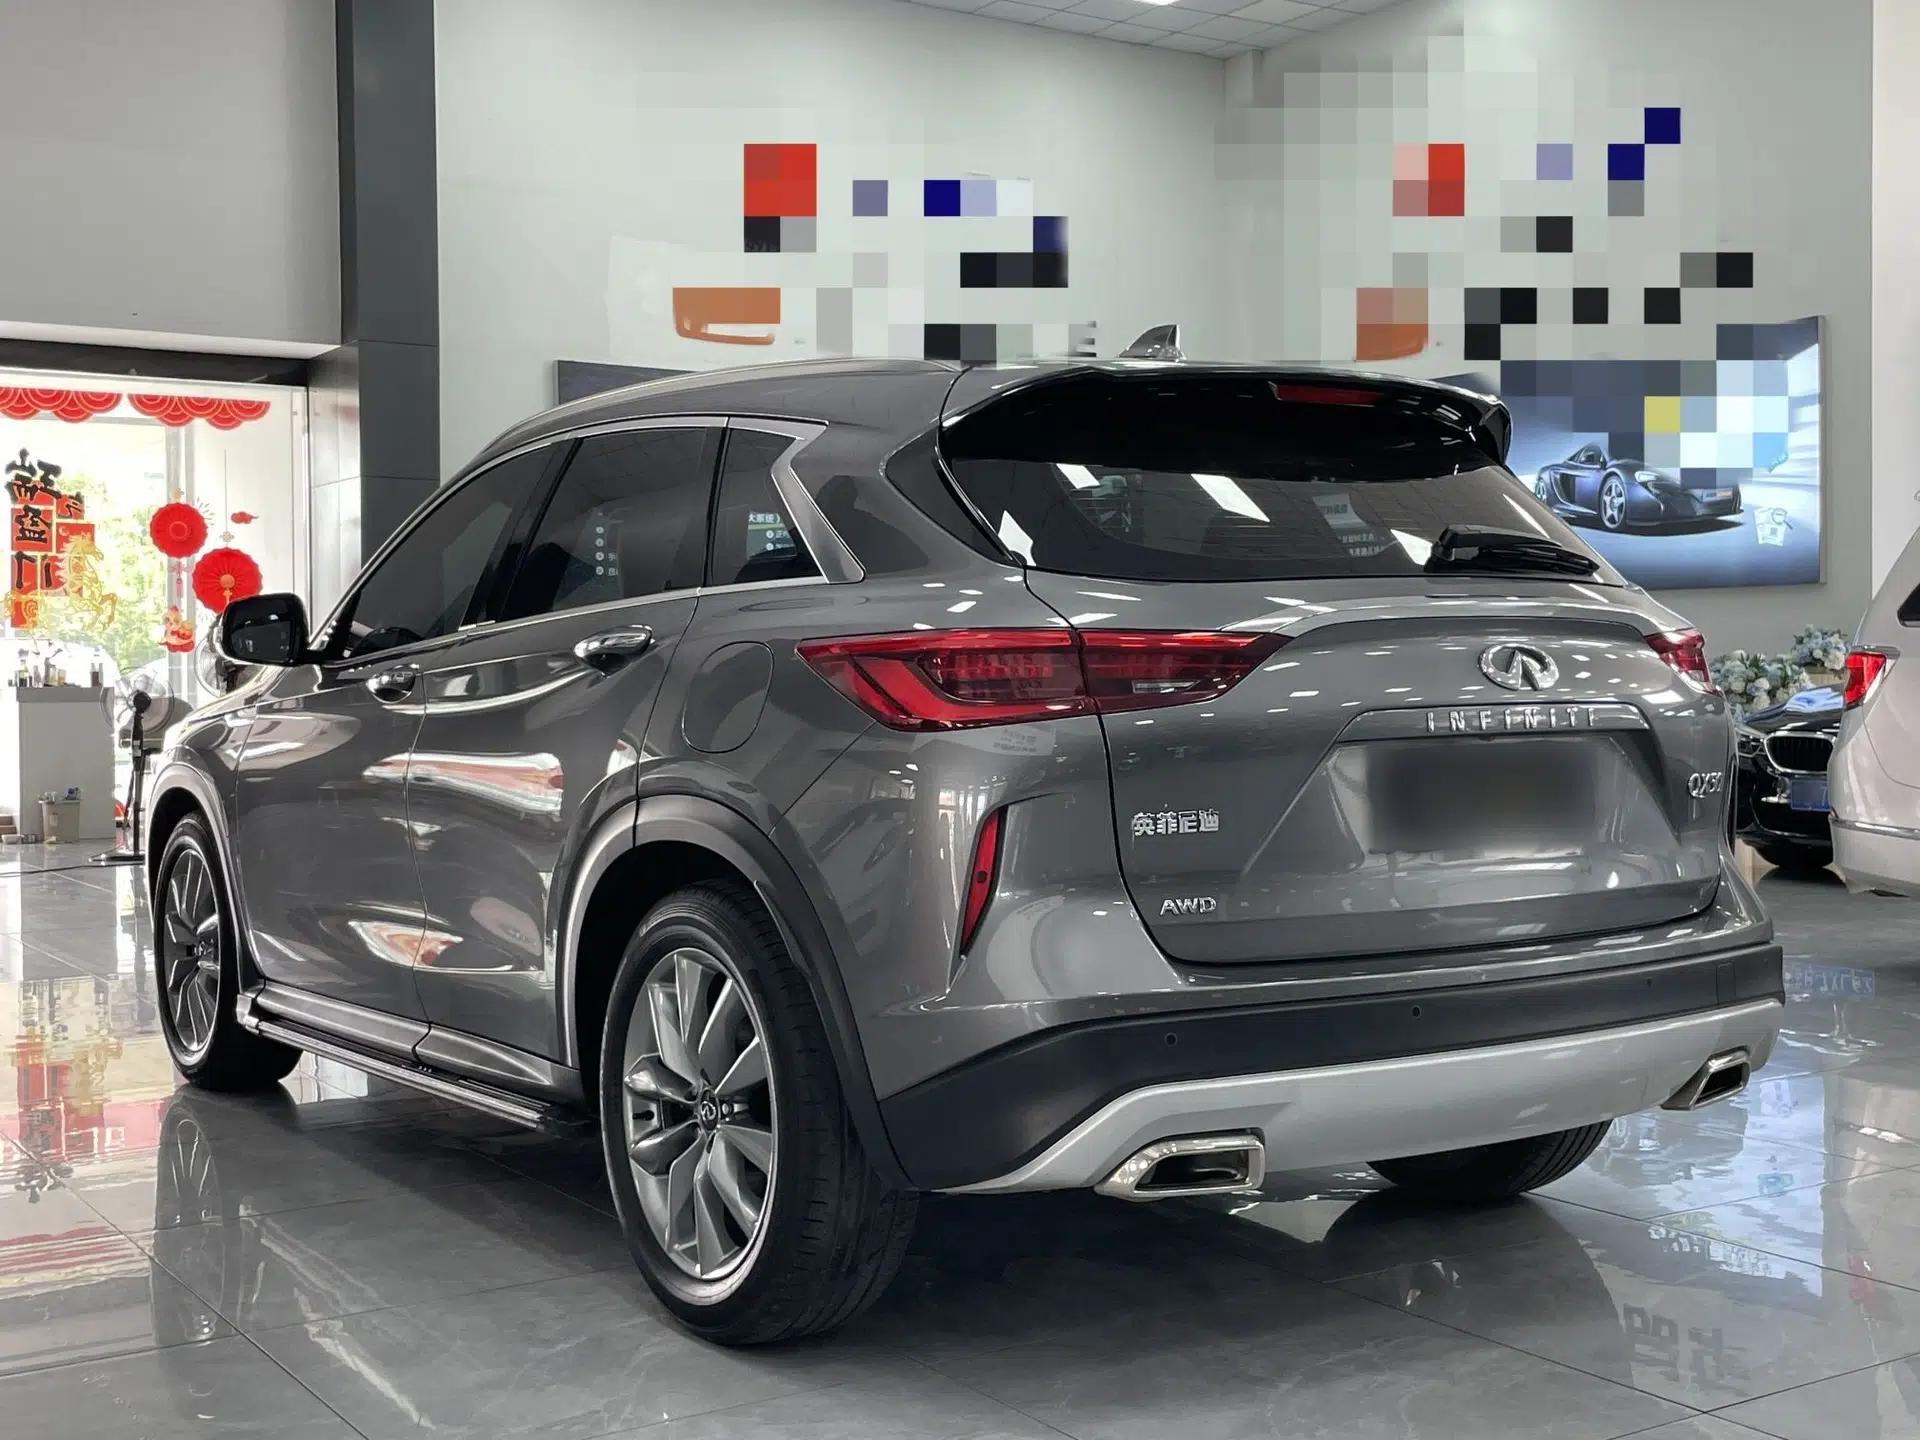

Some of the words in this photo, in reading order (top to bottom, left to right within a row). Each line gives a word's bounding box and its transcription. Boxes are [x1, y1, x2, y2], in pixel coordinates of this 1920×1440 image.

[1426, 707, 1596, 733] INFINITI
[1132, 809, 1220, 836] 英菲尼迪
[1160, 896, 1217, 916] AWD
